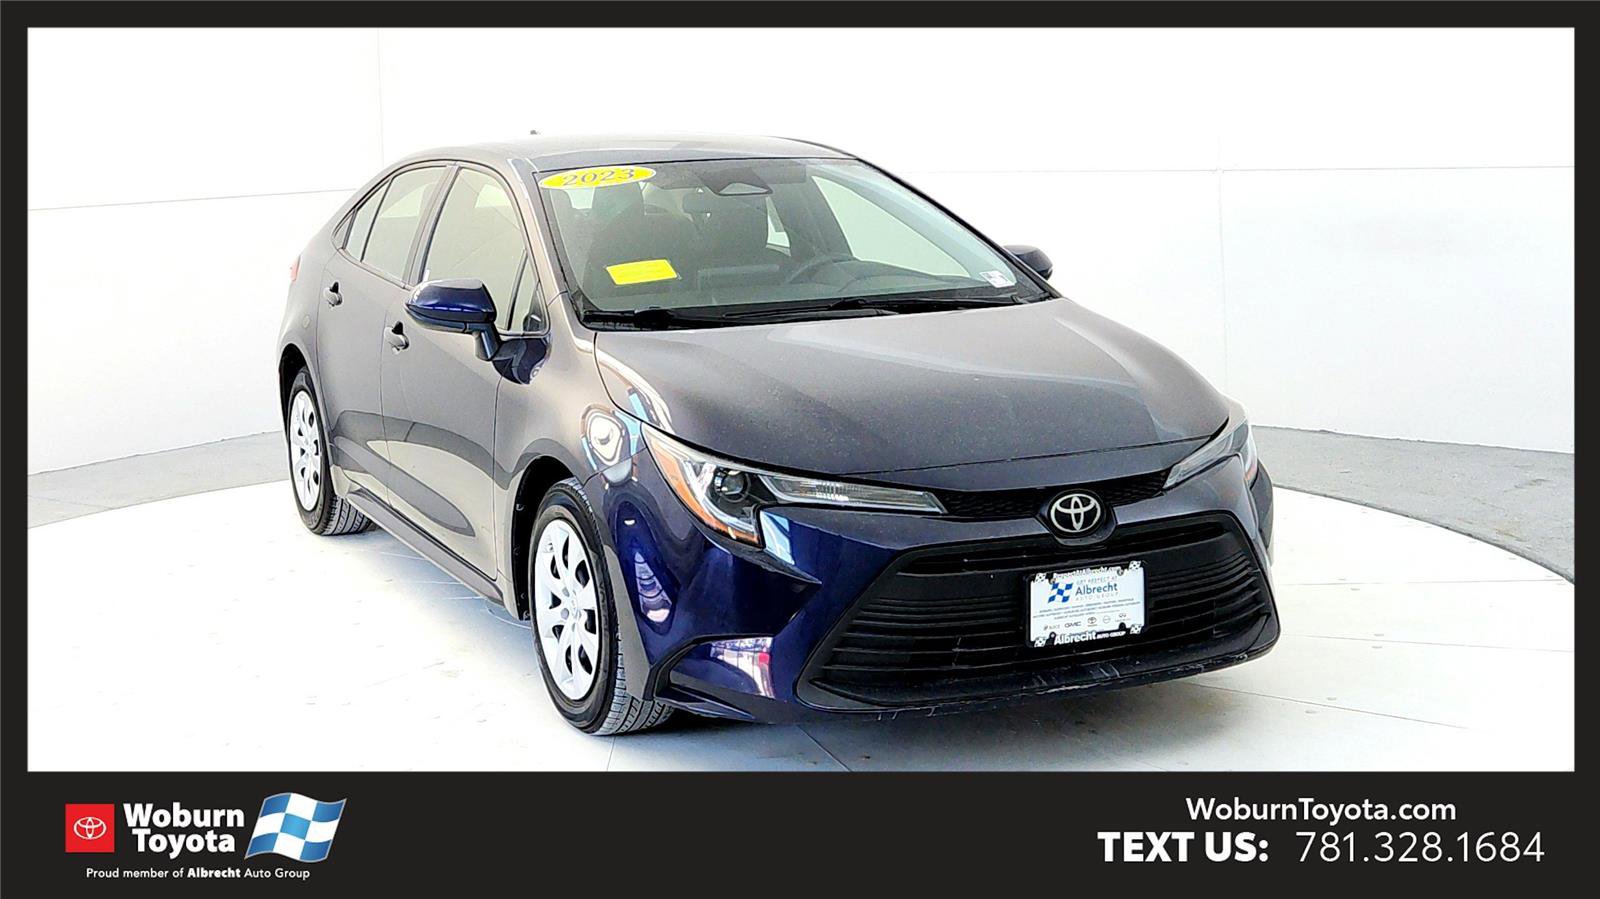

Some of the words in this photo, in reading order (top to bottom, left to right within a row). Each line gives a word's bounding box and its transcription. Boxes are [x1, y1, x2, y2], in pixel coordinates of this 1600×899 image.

[563, 168, 634, 186] 2023
[1075, 582, 1118, 595] Albrecht
[1064, 621, 1082, 629] GMC
[1054, 630, 1096, 645] Albrecht
